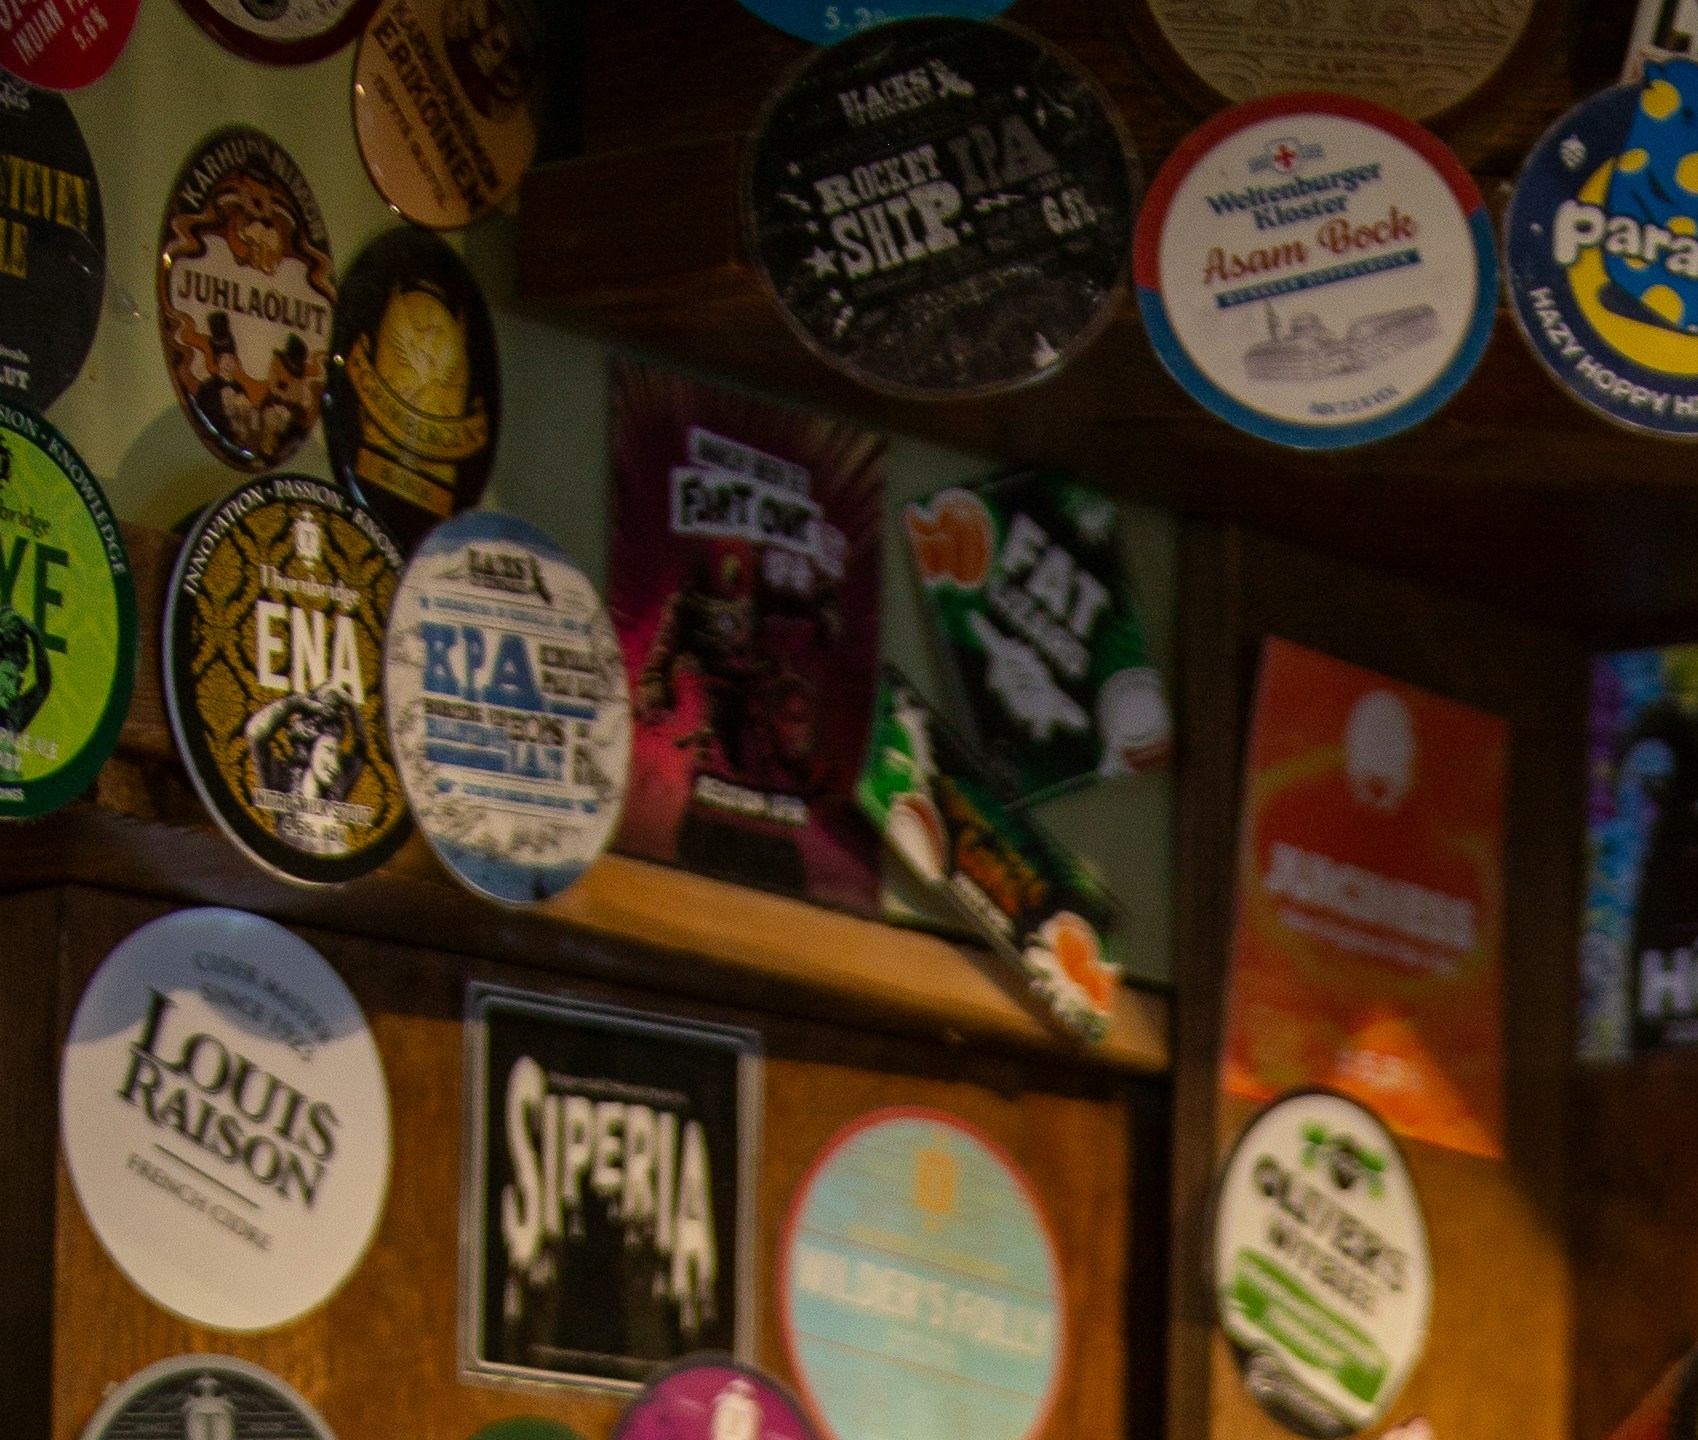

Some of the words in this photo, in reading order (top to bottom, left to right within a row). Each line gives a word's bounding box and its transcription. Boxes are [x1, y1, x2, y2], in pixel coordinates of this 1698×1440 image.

[813, 143, 942, 218] ROCKET
[950, 114, 1059, 197] IPA
[1205, 162, 1382, 220] Weltenburger
[1254, 193, 1352, 231] Kloster
[829, 181, 963, 281] SHIP
[1200, 242, 1310, 290] Asam
[1316, 207, 1420, 256] Bock
[177, 271, 332, 336] JUHLAOLUT
[1528, 285, 1584, 360] HAZY
[1574, 353, 1670, 416] HOPPY
[47, 434, 127, 577] KNOWLEDGE
[183, 486, 266, 596] INNOVATION
[272, 478, 346, 511] PASSION
[255, 599, 366, 706] ENA
[129, 985, 345, 1163] LOUIS
[115, 1051, 327, 1215] RAISON
[501, 1053, 718, 1305] SIPERIA
